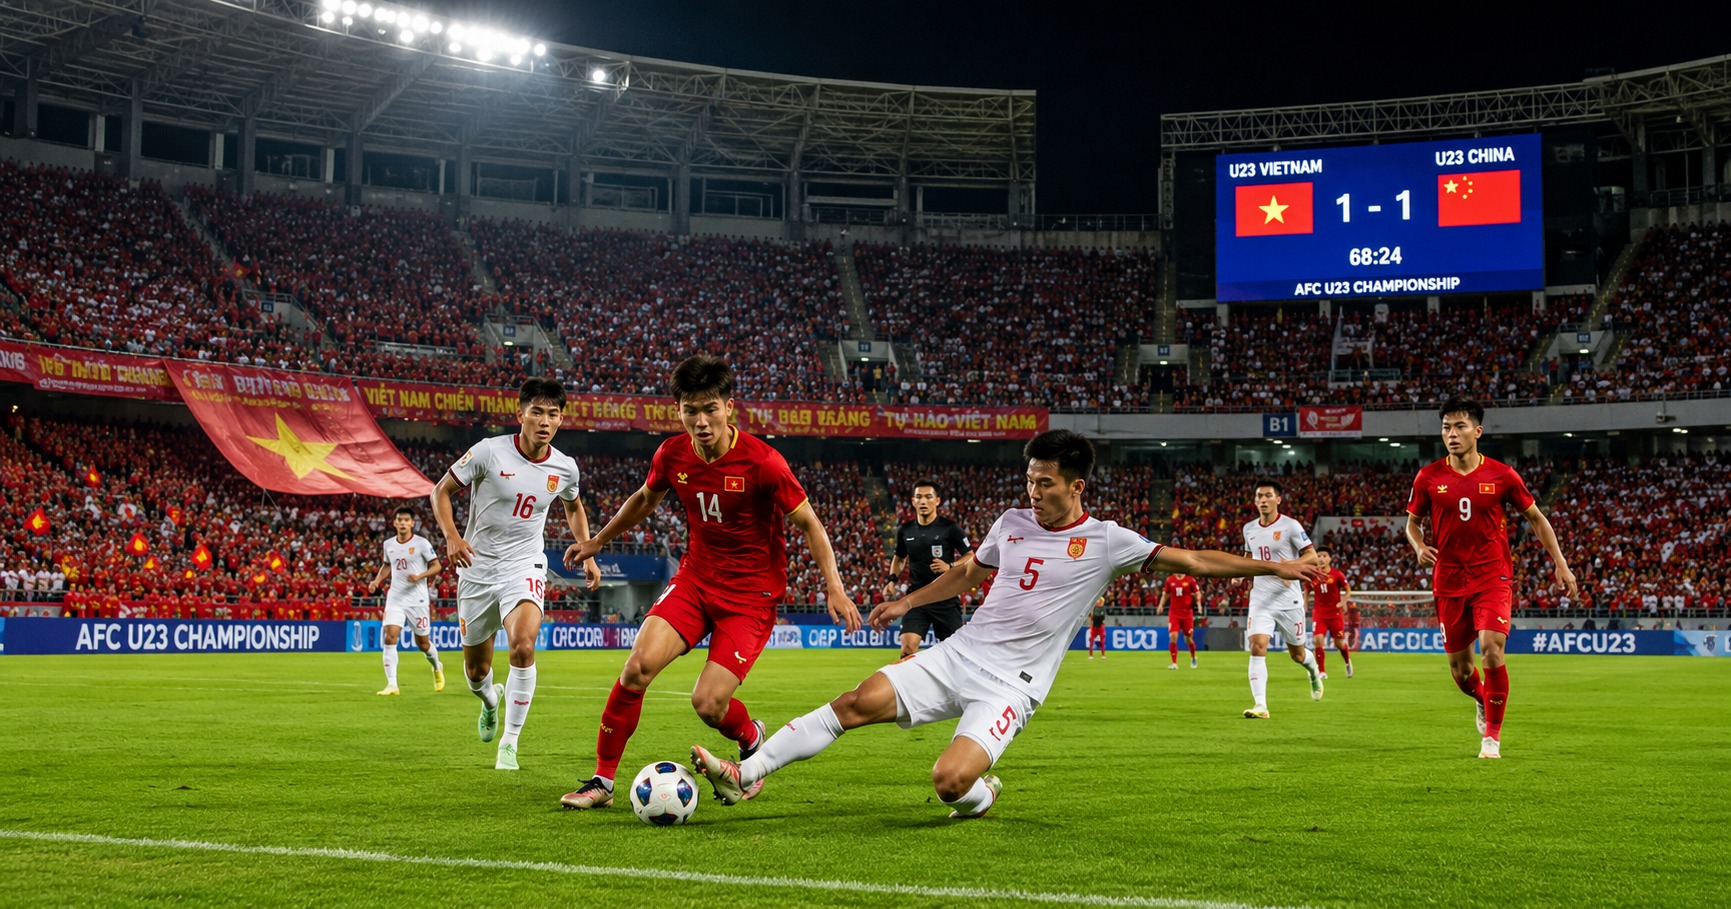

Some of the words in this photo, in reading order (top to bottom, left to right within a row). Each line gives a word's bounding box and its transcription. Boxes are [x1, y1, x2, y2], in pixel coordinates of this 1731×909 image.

[1436, 149, 1465, 166] U23
[1468, 146, 1515, 164] CHINA
[1229, 163, 1256, 178] U23
[1259, 158, 1323, 177] VIETNAM
[1336, 193, 1351, 223] 1
[1395, 189, 1411, 220] 1
[1349, 246, 1403, 266] 68:24
[1294, 282, 1322, 296] AFC
[1324, 281, 1351, 295] U23
[1353, 276, 1461, 294] CHAMPIONSHIP
[399, 390, 431, 409] NAM
[1269, 417, 1289, 432] B1
[512, 492, 537, 520] 16
[696, 491, 723, 524] 14
[1458, 497, 1472, 522] 9
[396, 558, 408, 571] 20
[1019, 557, 1045, 591] 5
[525, 577, 545, 600] 16
[416, 617, 428, 629] 20
[75, 623, 122, 651] AFC
[127, 623, 169, 650] U23
[173, 623, 320, 650] CHAMPIONSHIP
[1532, 632, 1636, 653] #AFCU23
[997, 705, 1017, 735] 5
